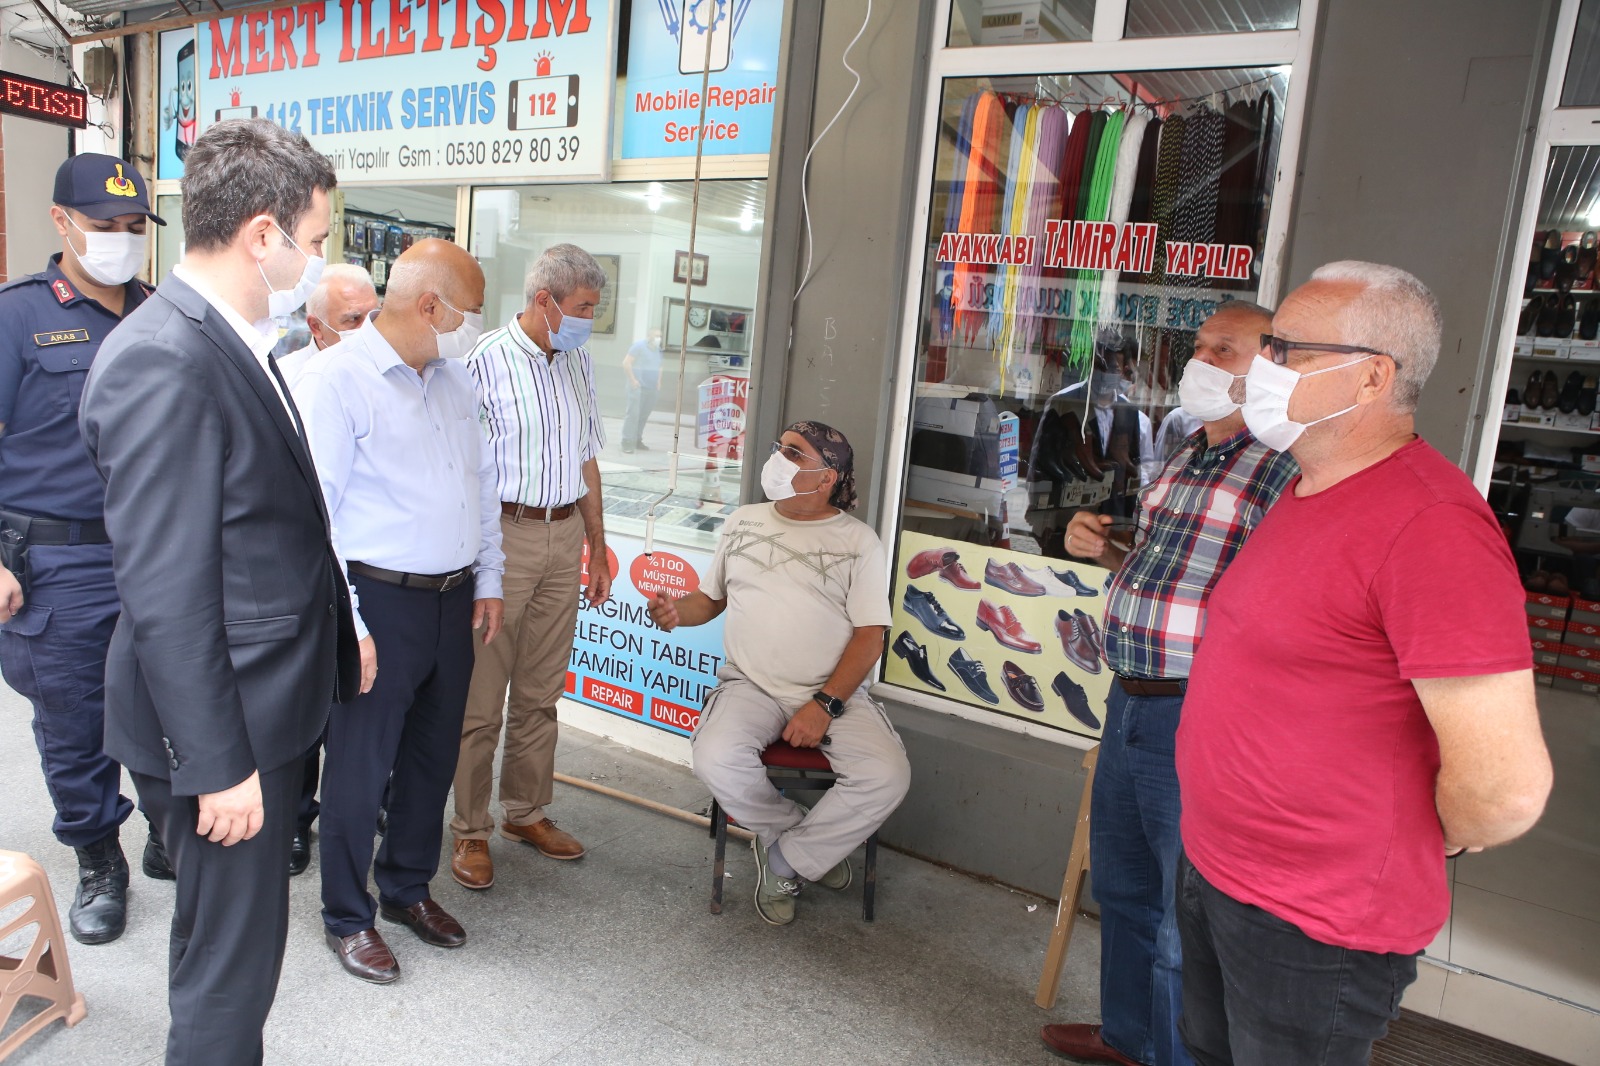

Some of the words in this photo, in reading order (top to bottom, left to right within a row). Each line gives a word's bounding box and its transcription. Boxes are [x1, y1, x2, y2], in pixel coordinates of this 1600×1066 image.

[208, 1, 326, 80] MERT
[529, 92, 557, 117] 112
[635, 89, 700, 113] Mobile
[707, 82, 776, 111] Repair
[664, 119, 739, 143] Service
[398, 144, 431, 167] Gsm
[446, 141, 486, 166] 0530
[492, 138, 523, 164] 829
[529, 137, 551, 162] 80
[557, 135, 580, 162] 39
[936, 232, 1036, 266] AYAKKABI
[1165, 240, 1253, 279] YAPILIR
[50, 333, 76, 342] ARAS
[739, 520, 764, 528] DUCATI
[650, 639, 721, 677] TABLET
[654, 704, 700, 727] UNLOC
